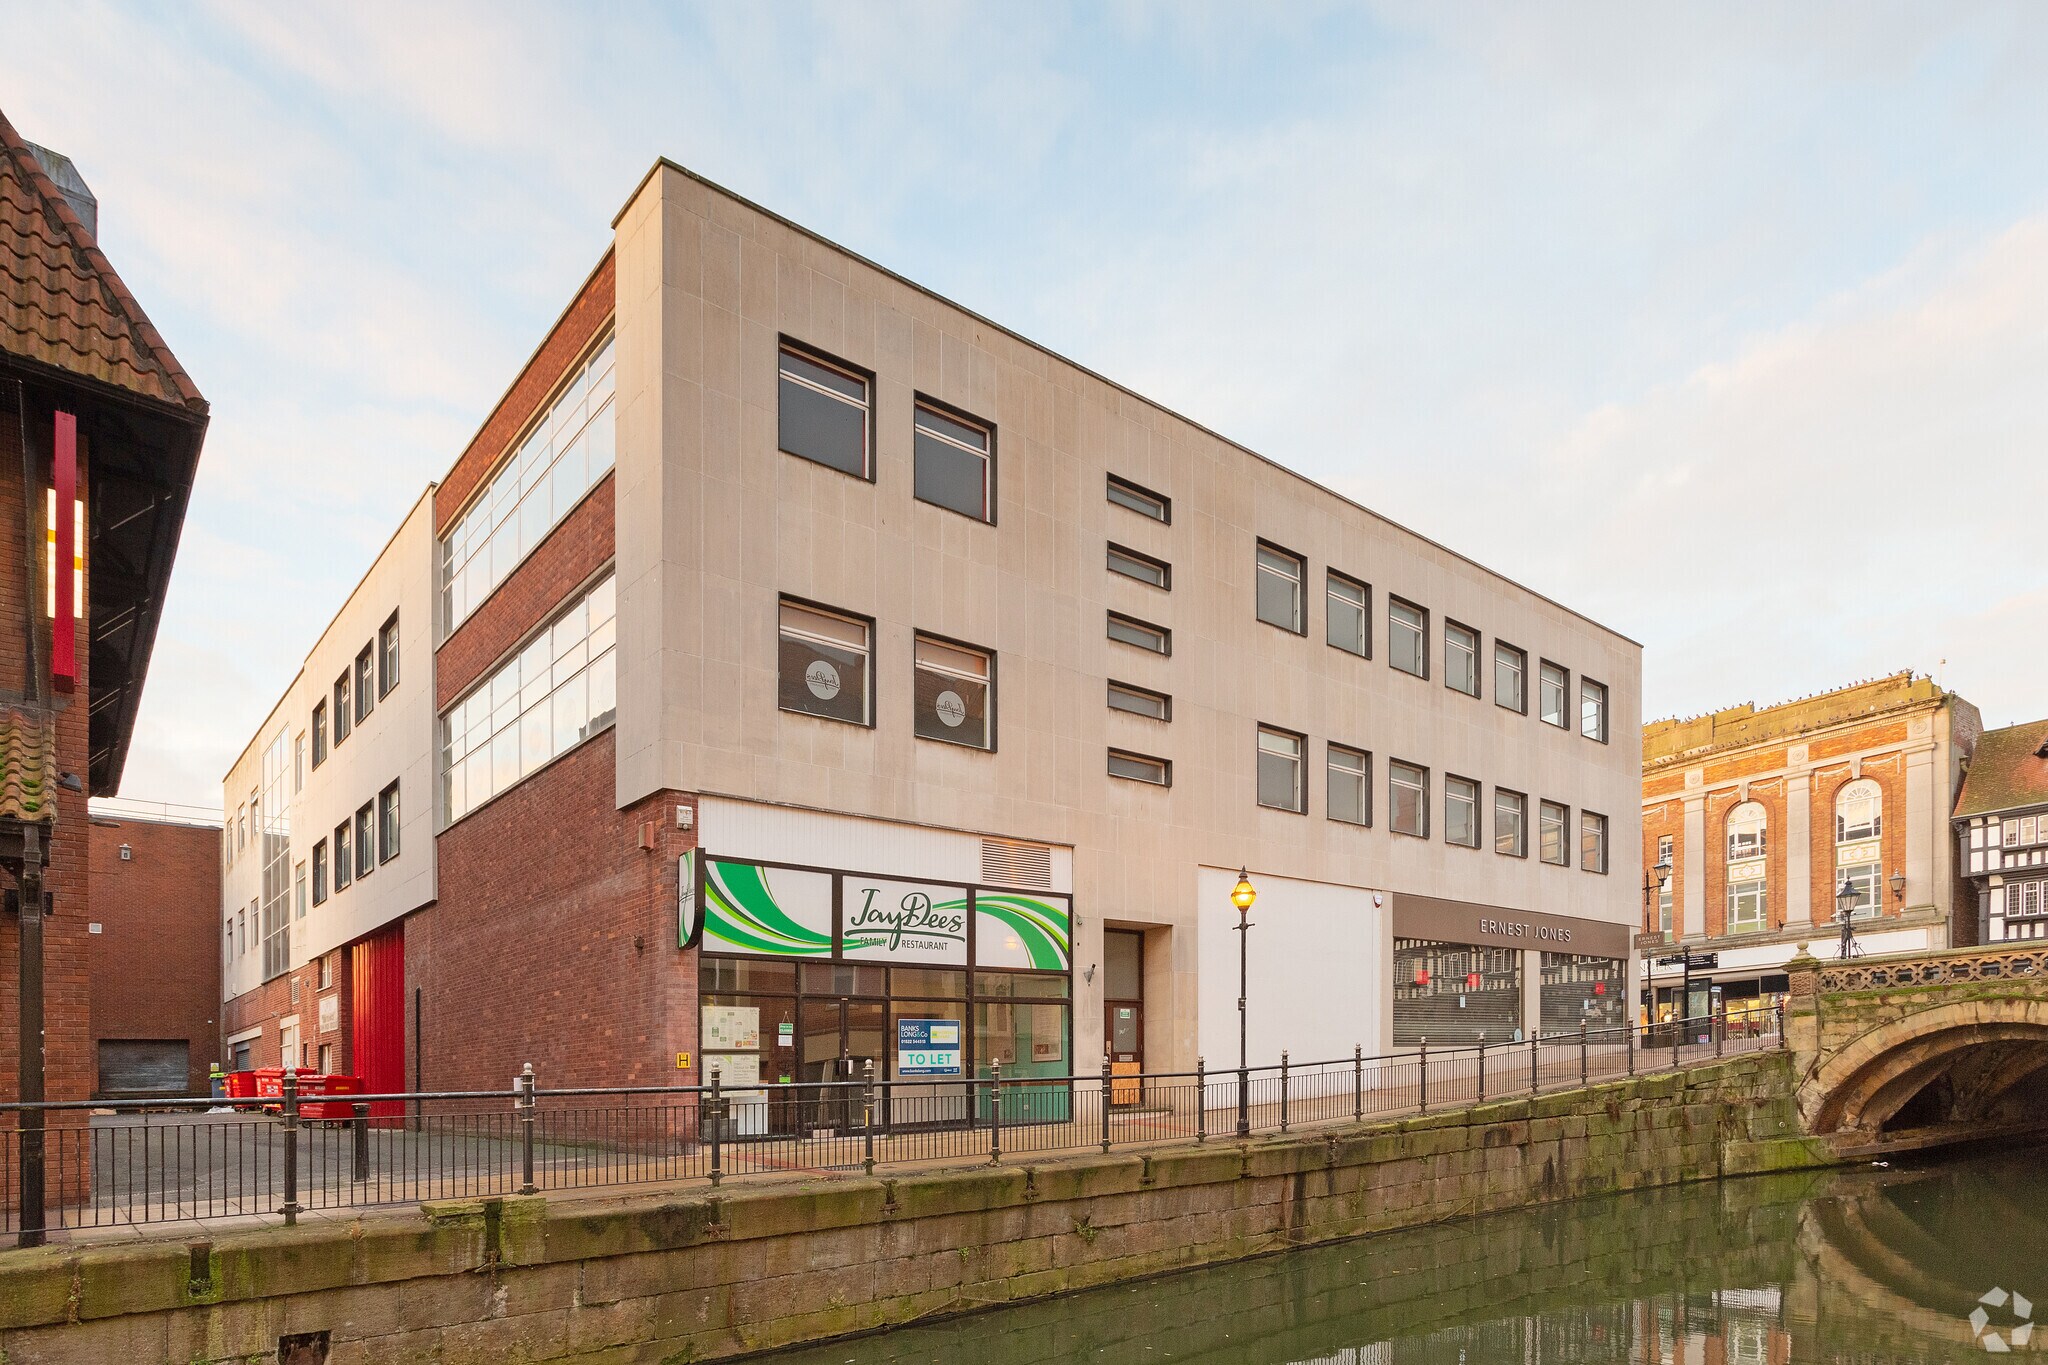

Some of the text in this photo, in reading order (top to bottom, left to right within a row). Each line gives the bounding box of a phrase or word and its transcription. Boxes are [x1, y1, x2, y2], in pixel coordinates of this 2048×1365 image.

[851, 888, 965, 951] JayDees
[1480, 919, 1571, 942] ERNEST JONES
[860, 936, 948, 951] FAMILY RESTAURANT
[678, 1054, 689, 1067] H
[908, 1053, 952, 1065] TO LET
